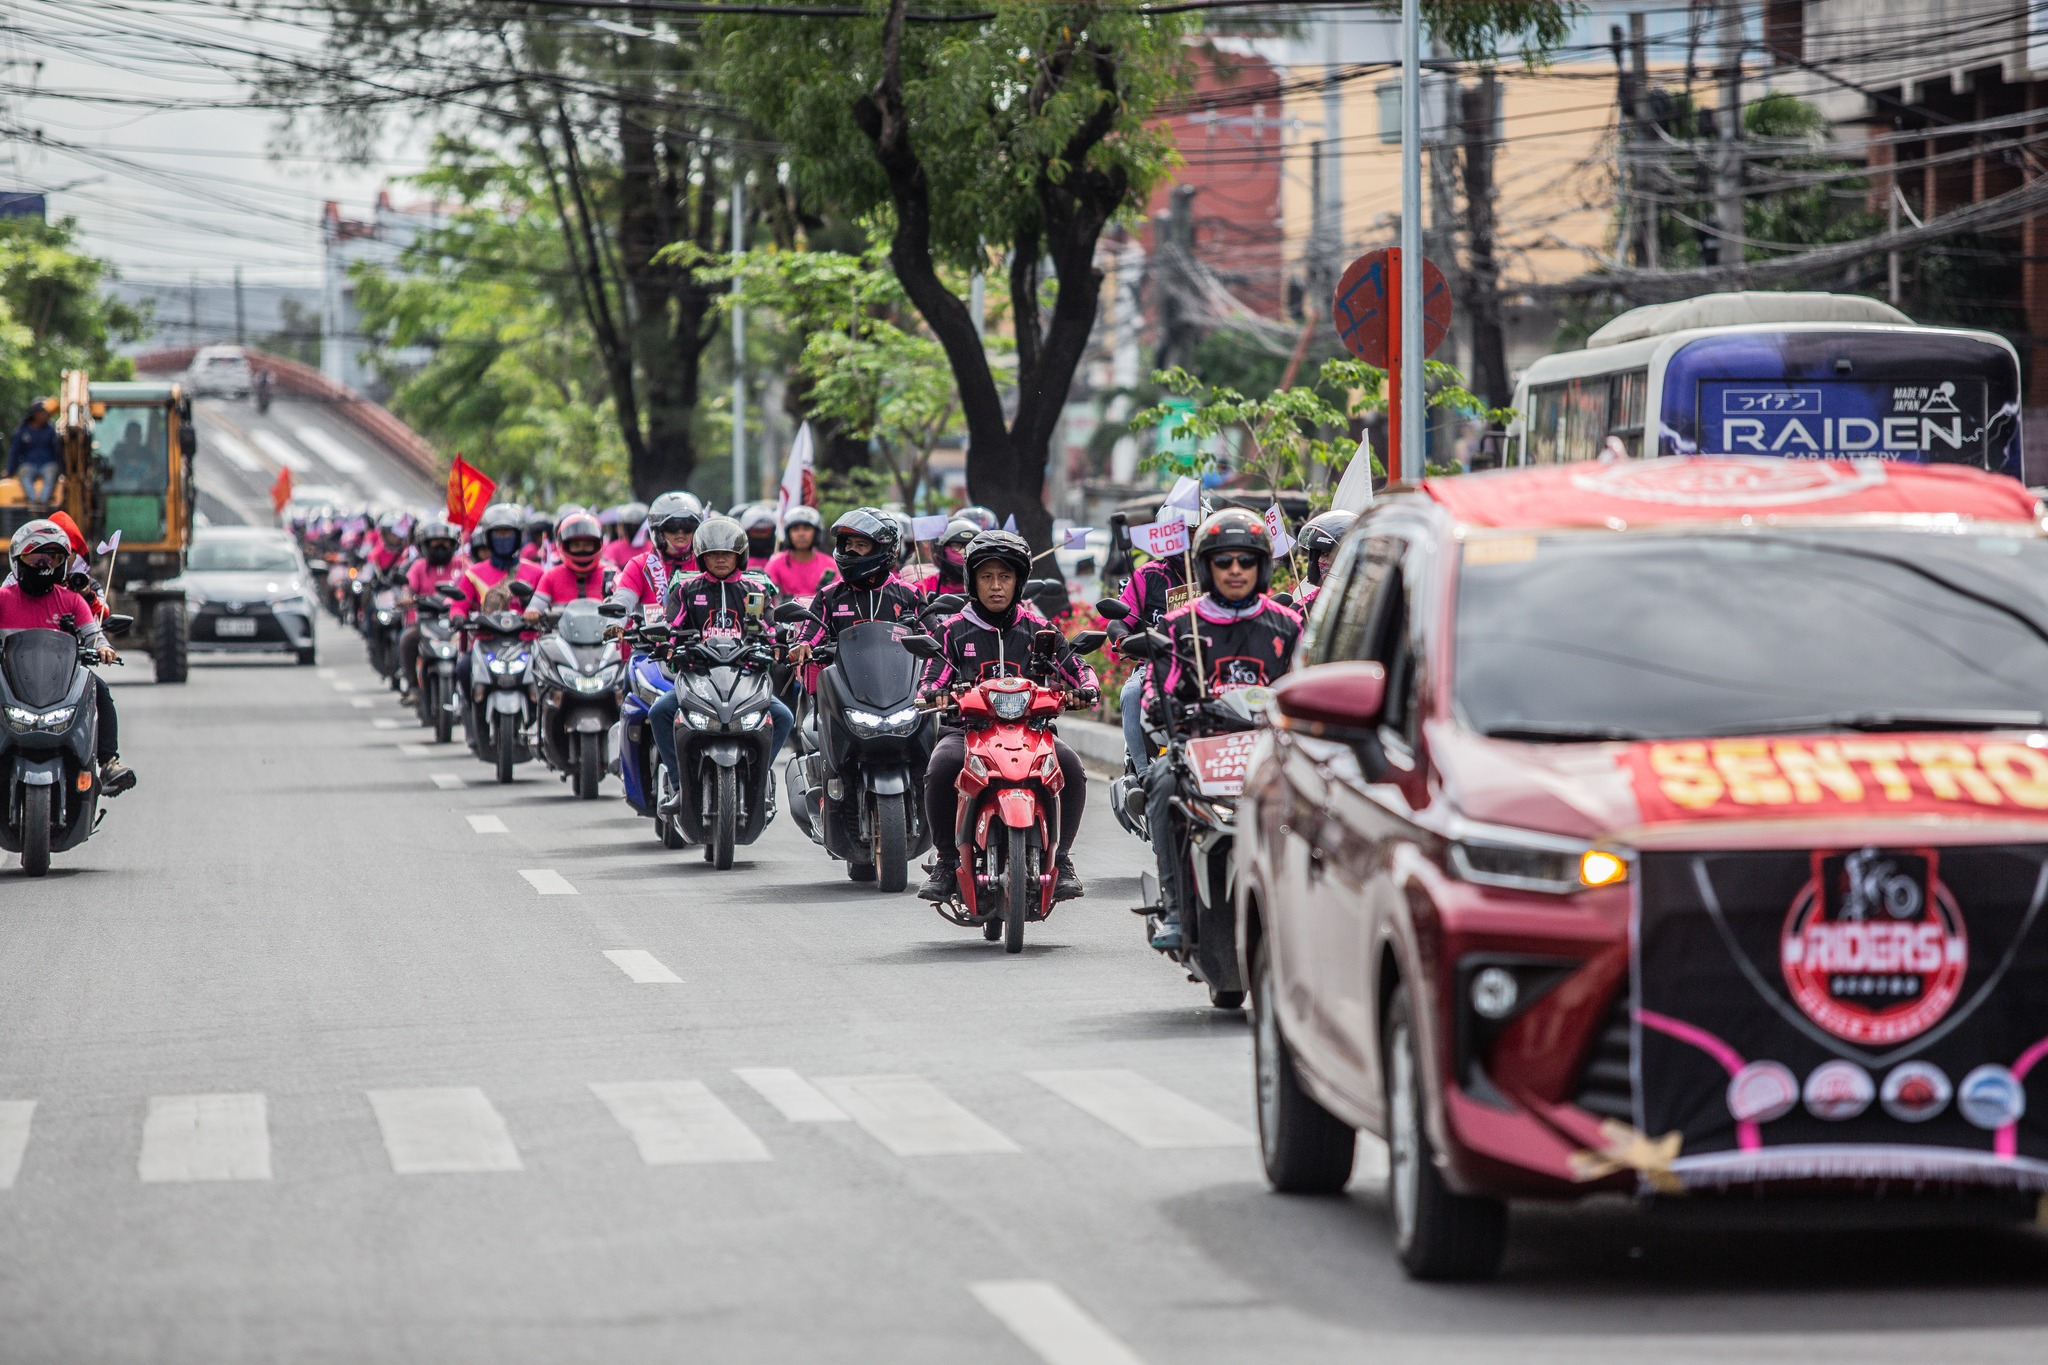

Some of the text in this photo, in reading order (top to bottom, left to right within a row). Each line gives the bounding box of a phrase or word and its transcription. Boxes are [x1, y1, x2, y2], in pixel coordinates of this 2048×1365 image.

[1893, 387, 1928, 399] MADE IN
[1893, 400, 1920, 412] JAPAN
[1723, 418, 1962, 451] RAIDEN
[1169, 592, 1188, 603] DUE
[1649, 741, 2048, 810] SENTRO
[1804, 922, 1943, 971] RIDERS
